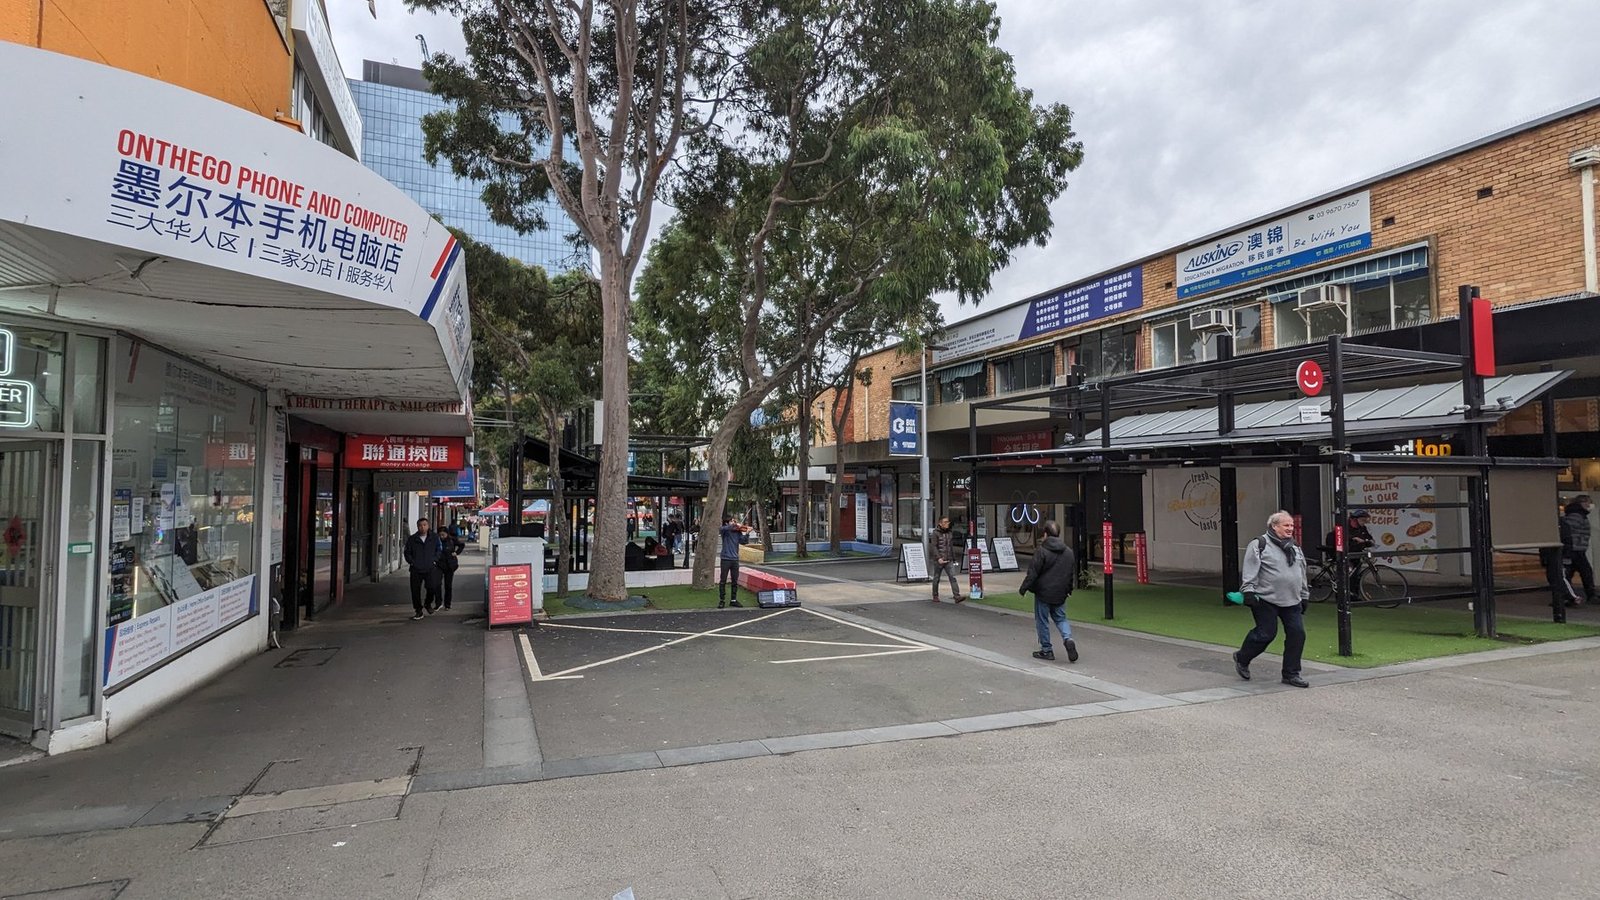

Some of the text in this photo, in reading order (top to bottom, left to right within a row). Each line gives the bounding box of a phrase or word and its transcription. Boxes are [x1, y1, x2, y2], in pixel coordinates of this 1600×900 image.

[117, 129, 409, 244] ONTHEGO PHONE AND COMPUTER
[111, 159, 404, 275] 墨尔本手机电脑店
[1316, 199, 1360, 219] 03 9670 7567
[1247, 226, 1283, 251] 澳锦
[1293, 222, 1361, 249] Be With You
[106, 204, 394, 294] 三大华人区 三家分店 服务华人
[1187, 243, 1239, 269] AUSKING
[1248, 246, 1284, 264] 移民留学
[1184, 269, 1211, 282] EDUCATION
[1216, 260, 1245, 273] MIGRATION
[296, 397, 333, 410] BEAUTY
[338, 398, 386, 411] THERAPY
[400, 401, 423, 412] NAIL
[426, 401, 463, 413] CENTRE
[362, 443, 449, 463] 聯通換匯
[1362, 482, 1399, 492] QUALITY
[1364, 492, 1398, 504] IS OUR
